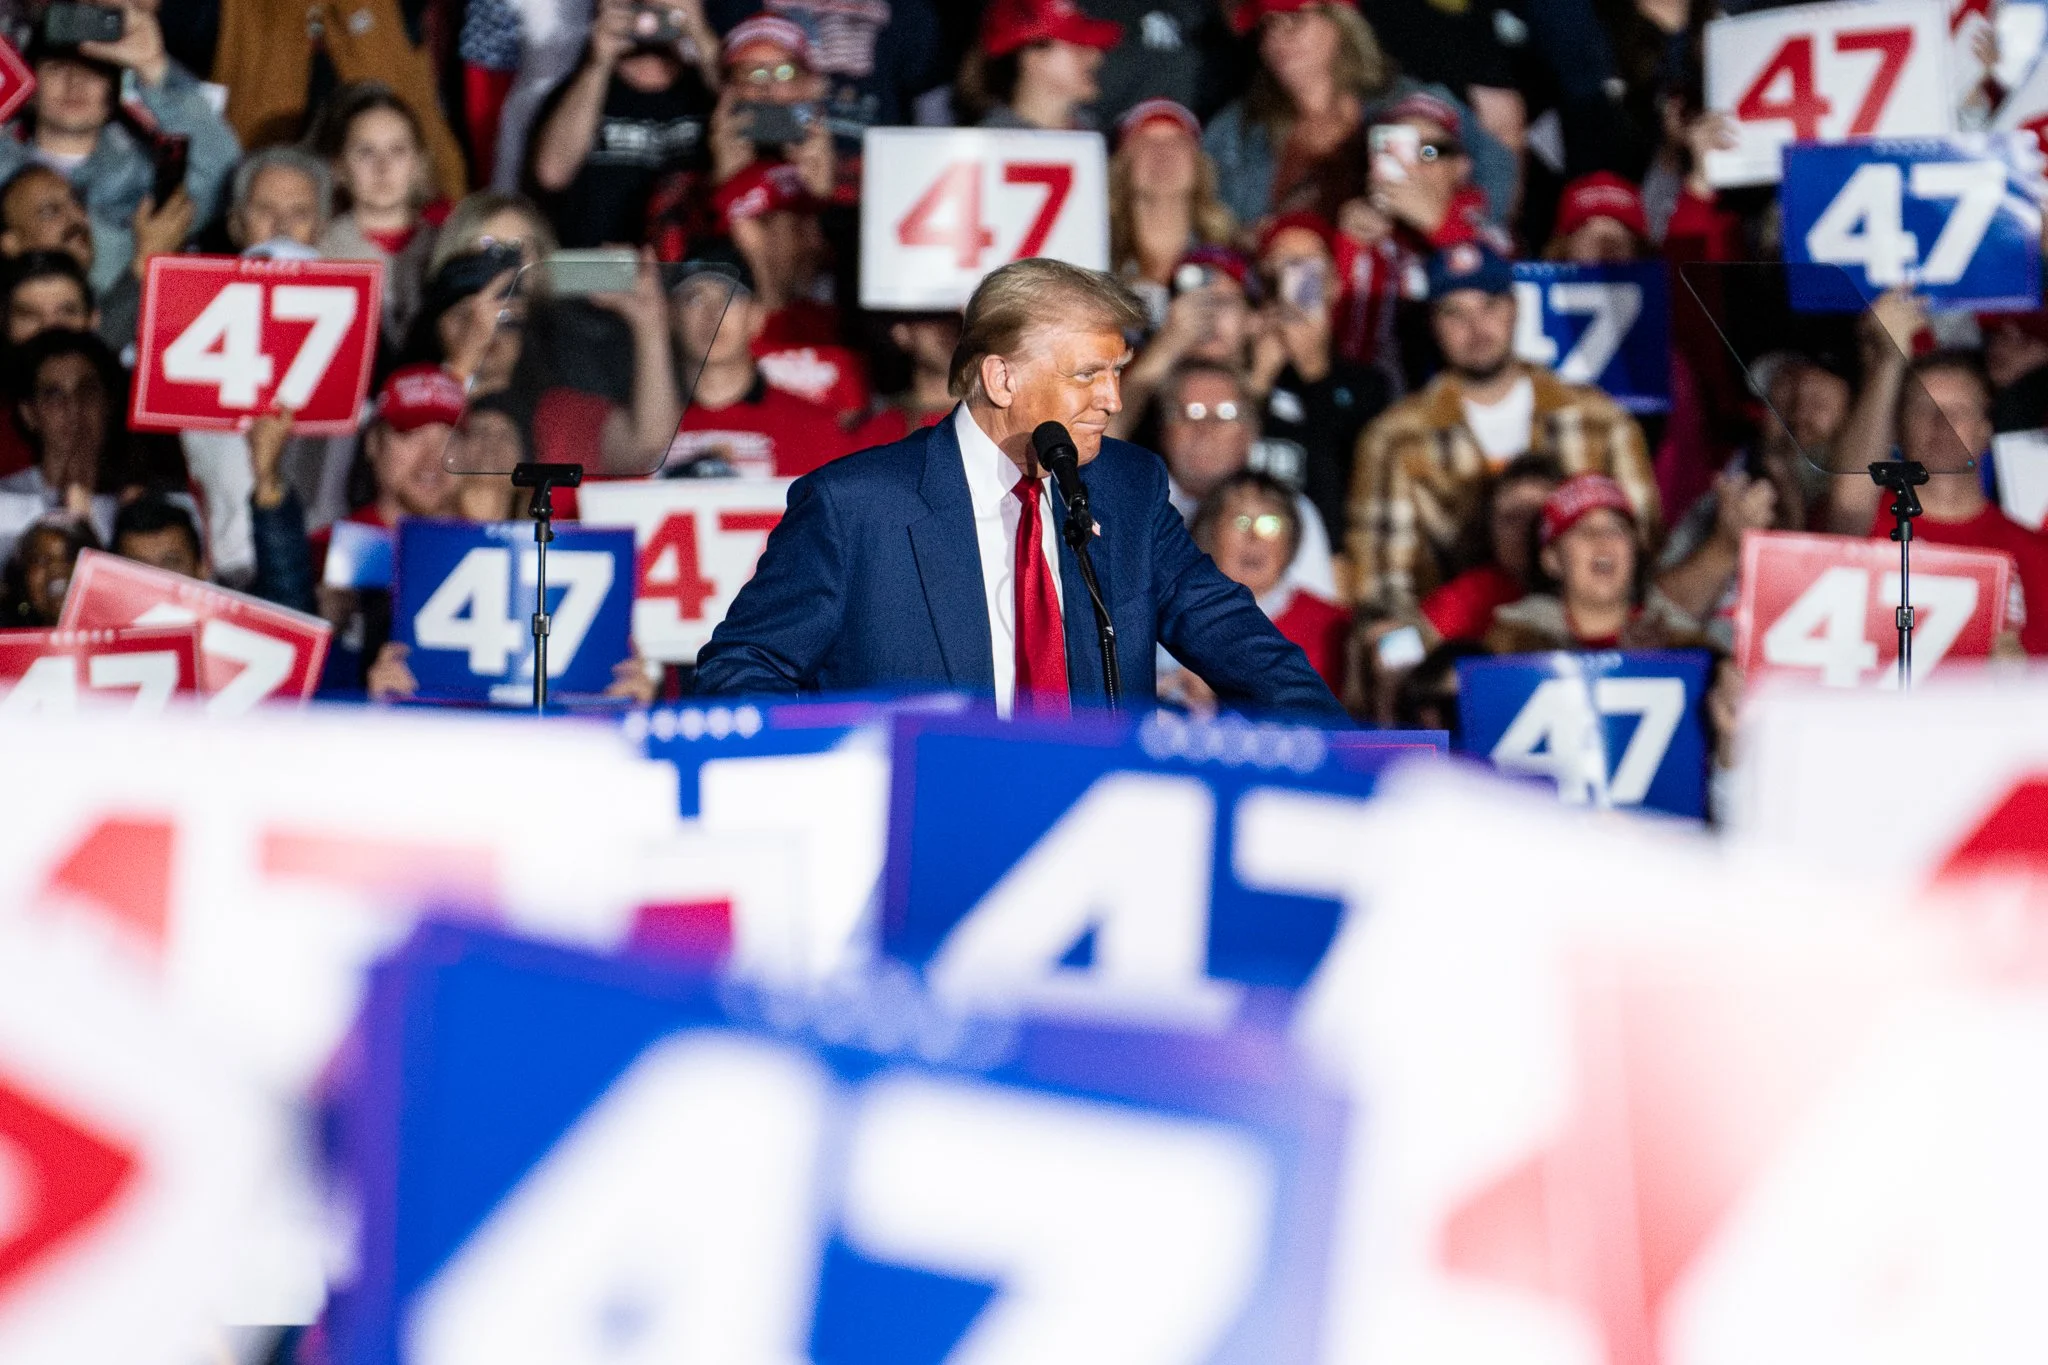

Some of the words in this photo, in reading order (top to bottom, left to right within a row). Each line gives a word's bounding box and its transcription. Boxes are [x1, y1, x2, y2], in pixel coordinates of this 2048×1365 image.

[1735, 24, 1915, 143] 47
[896, 161, 1074, 269] 47
[1806, 161, 2006, 287] 47
[163, 281, 358, 409] 47
[131, 603, 297, 714] 7
[414, 548, 615, 677] 47
[1764, 566, 1978, 690] 47
[1490, 676, 1685, 806] 47
[410, 1025, 1280, 1365] 47
